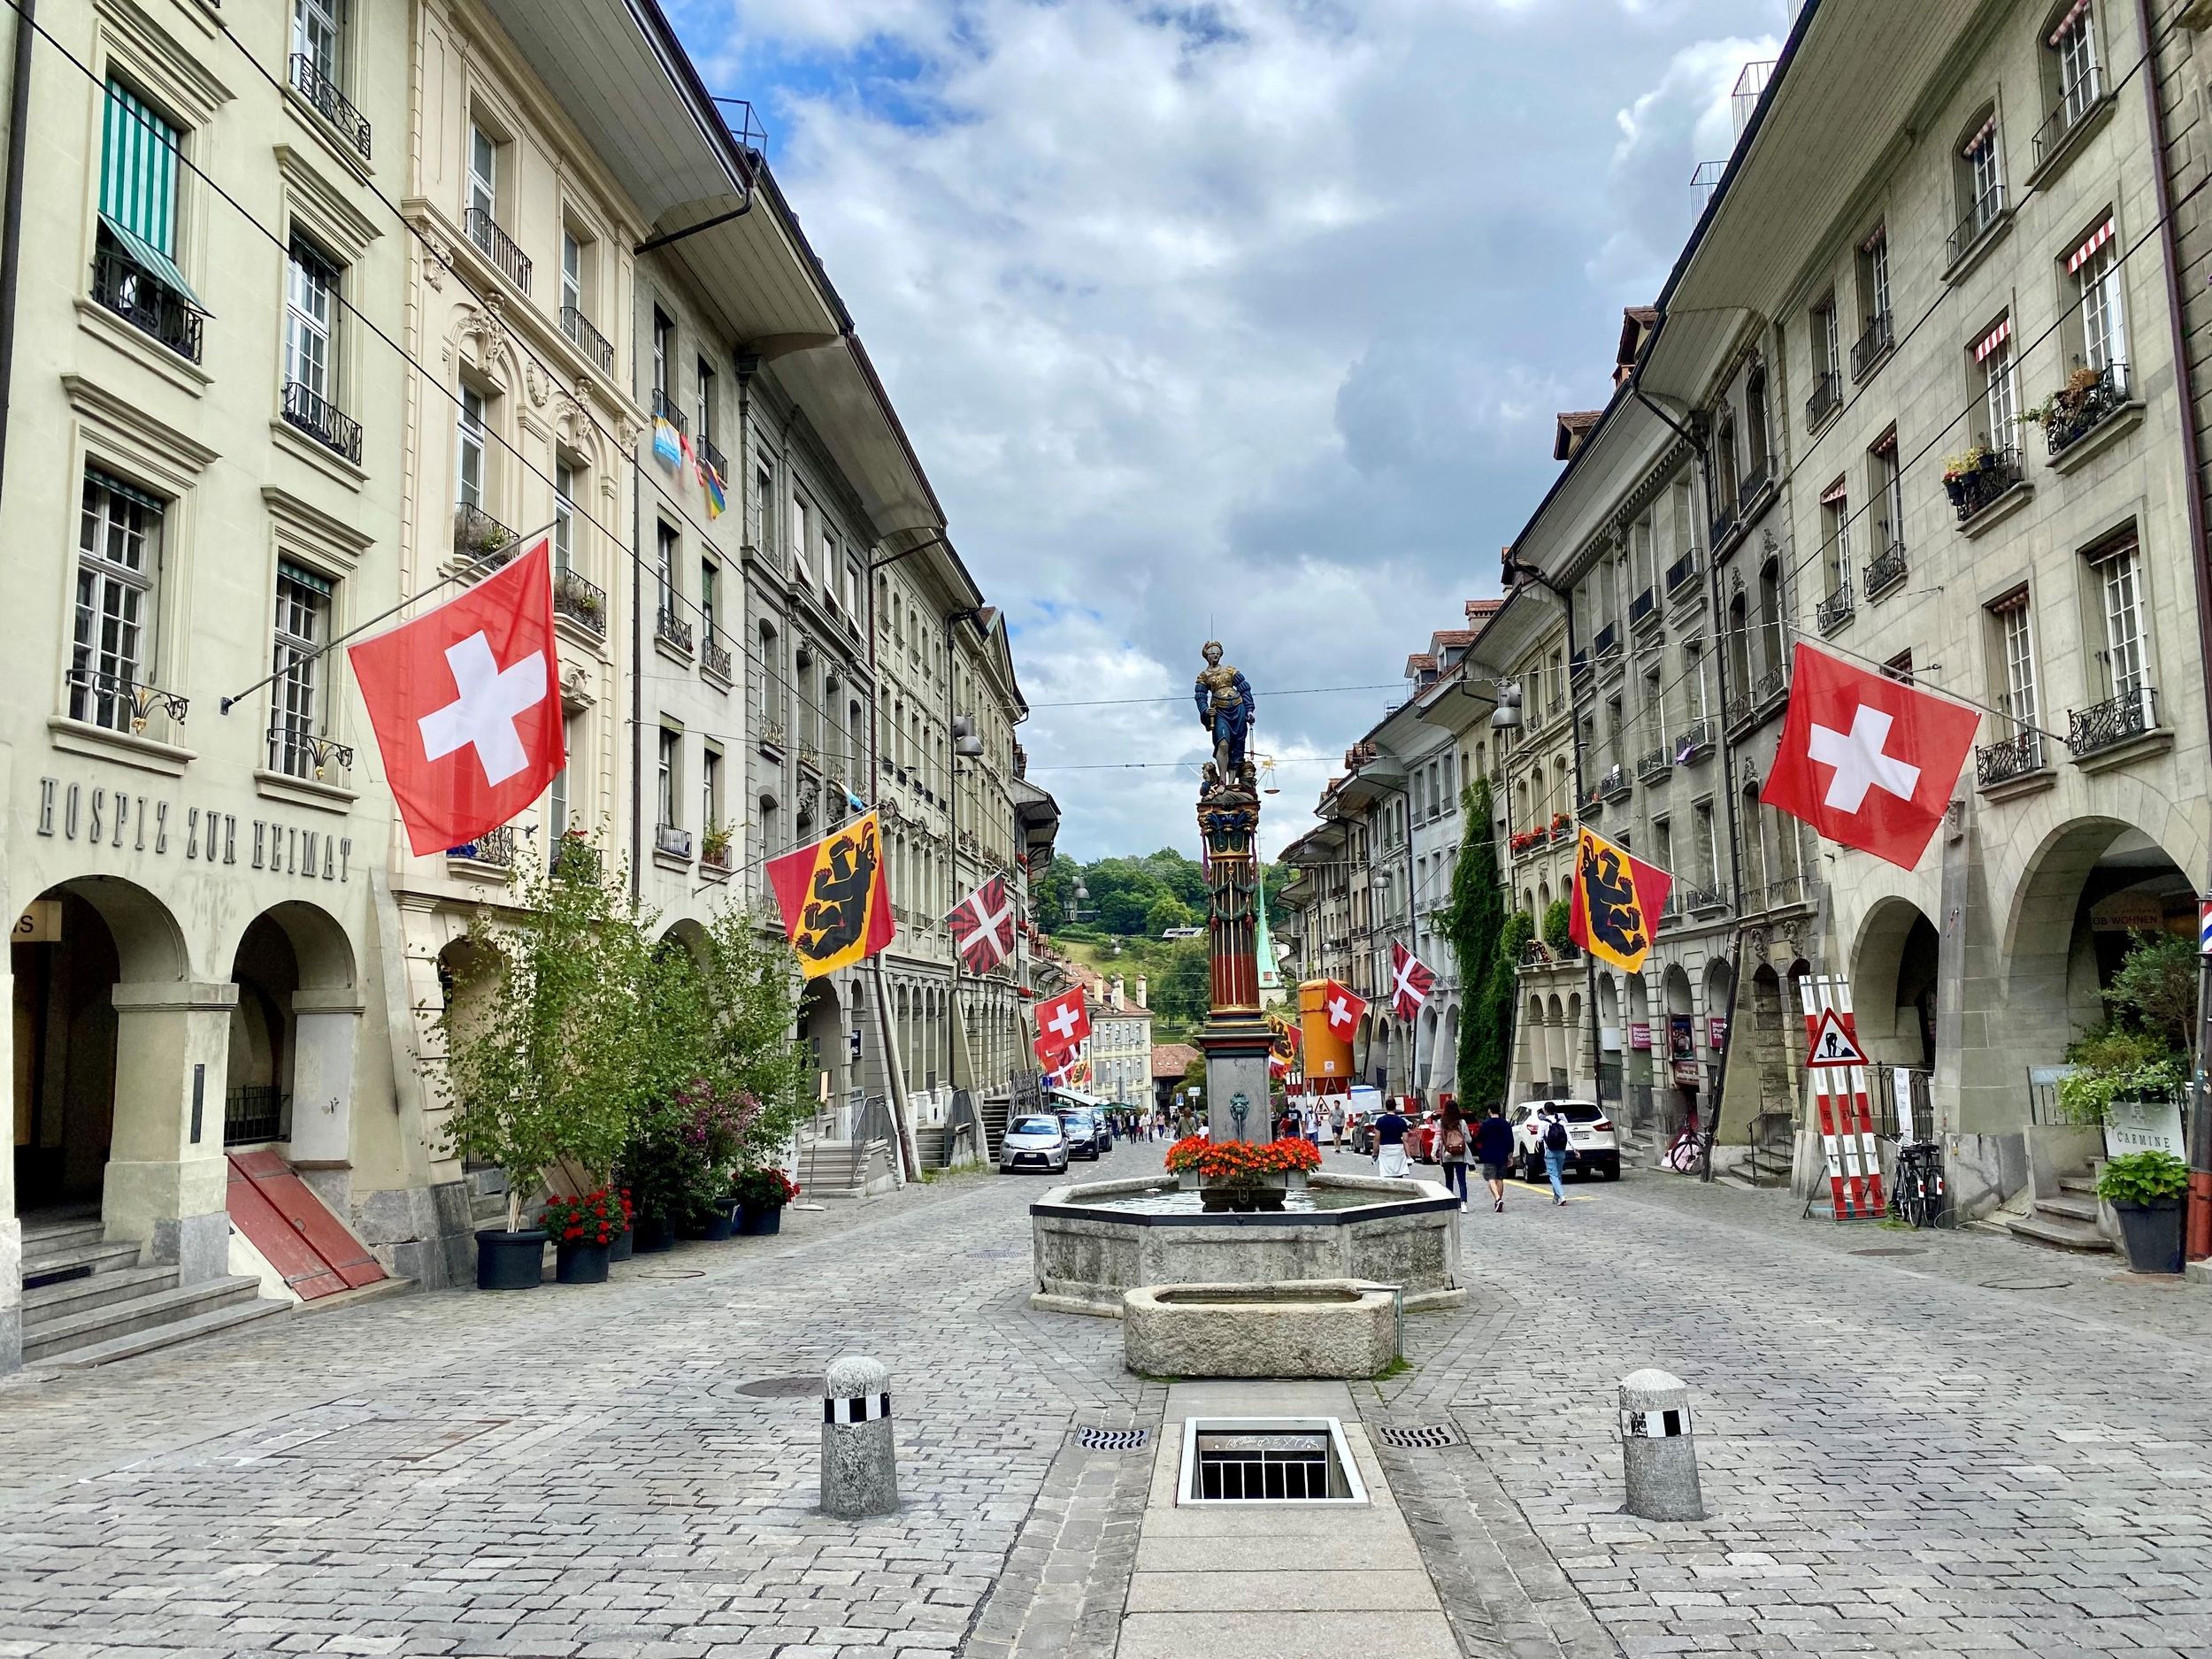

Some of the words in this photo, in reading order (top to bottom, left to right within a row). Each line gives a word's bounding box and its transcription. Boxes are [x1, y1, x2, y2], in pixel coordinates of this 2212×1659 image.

[37, 776, 170, 854] HOSPIZ
[187, 806, 237, 864] ZUR
[251, 819, 352, 882] HEIMAT
[2111, 915, 2157, 925] WOHNEN
[2117, 1132, 2170, 1148] CARMINE
